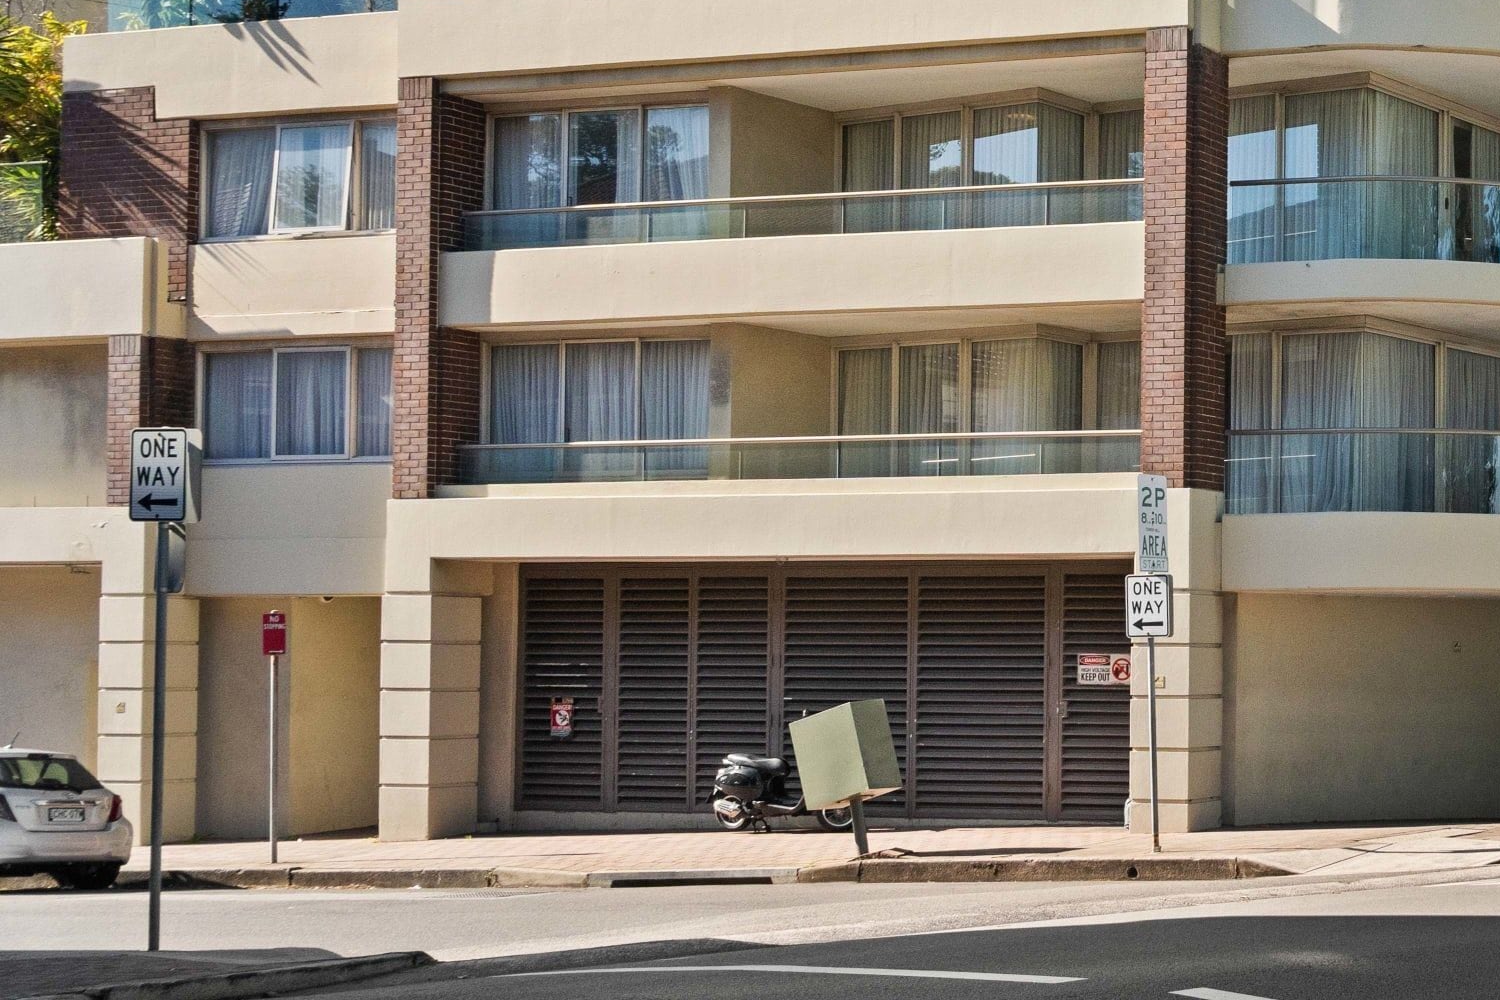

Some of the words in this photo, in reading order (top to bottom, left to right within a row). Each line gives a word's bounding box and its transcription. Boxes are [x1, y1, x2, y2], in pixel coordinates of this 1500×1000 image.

[140, 438, 178, 458] ONE
[136, 466, 180, 486] WAY
[1141, 486, 1166, 507] 2P
[1141, 535, 1167, 556] AREA
[1143, 560, 1166, 569] START
[1133, 581, 1162, 595] ONE
[1131, 600, 1163, 614] WAY
[1080, 672, 1096, 681] KEEP
[1097, 672, 1110, 681] OUT
